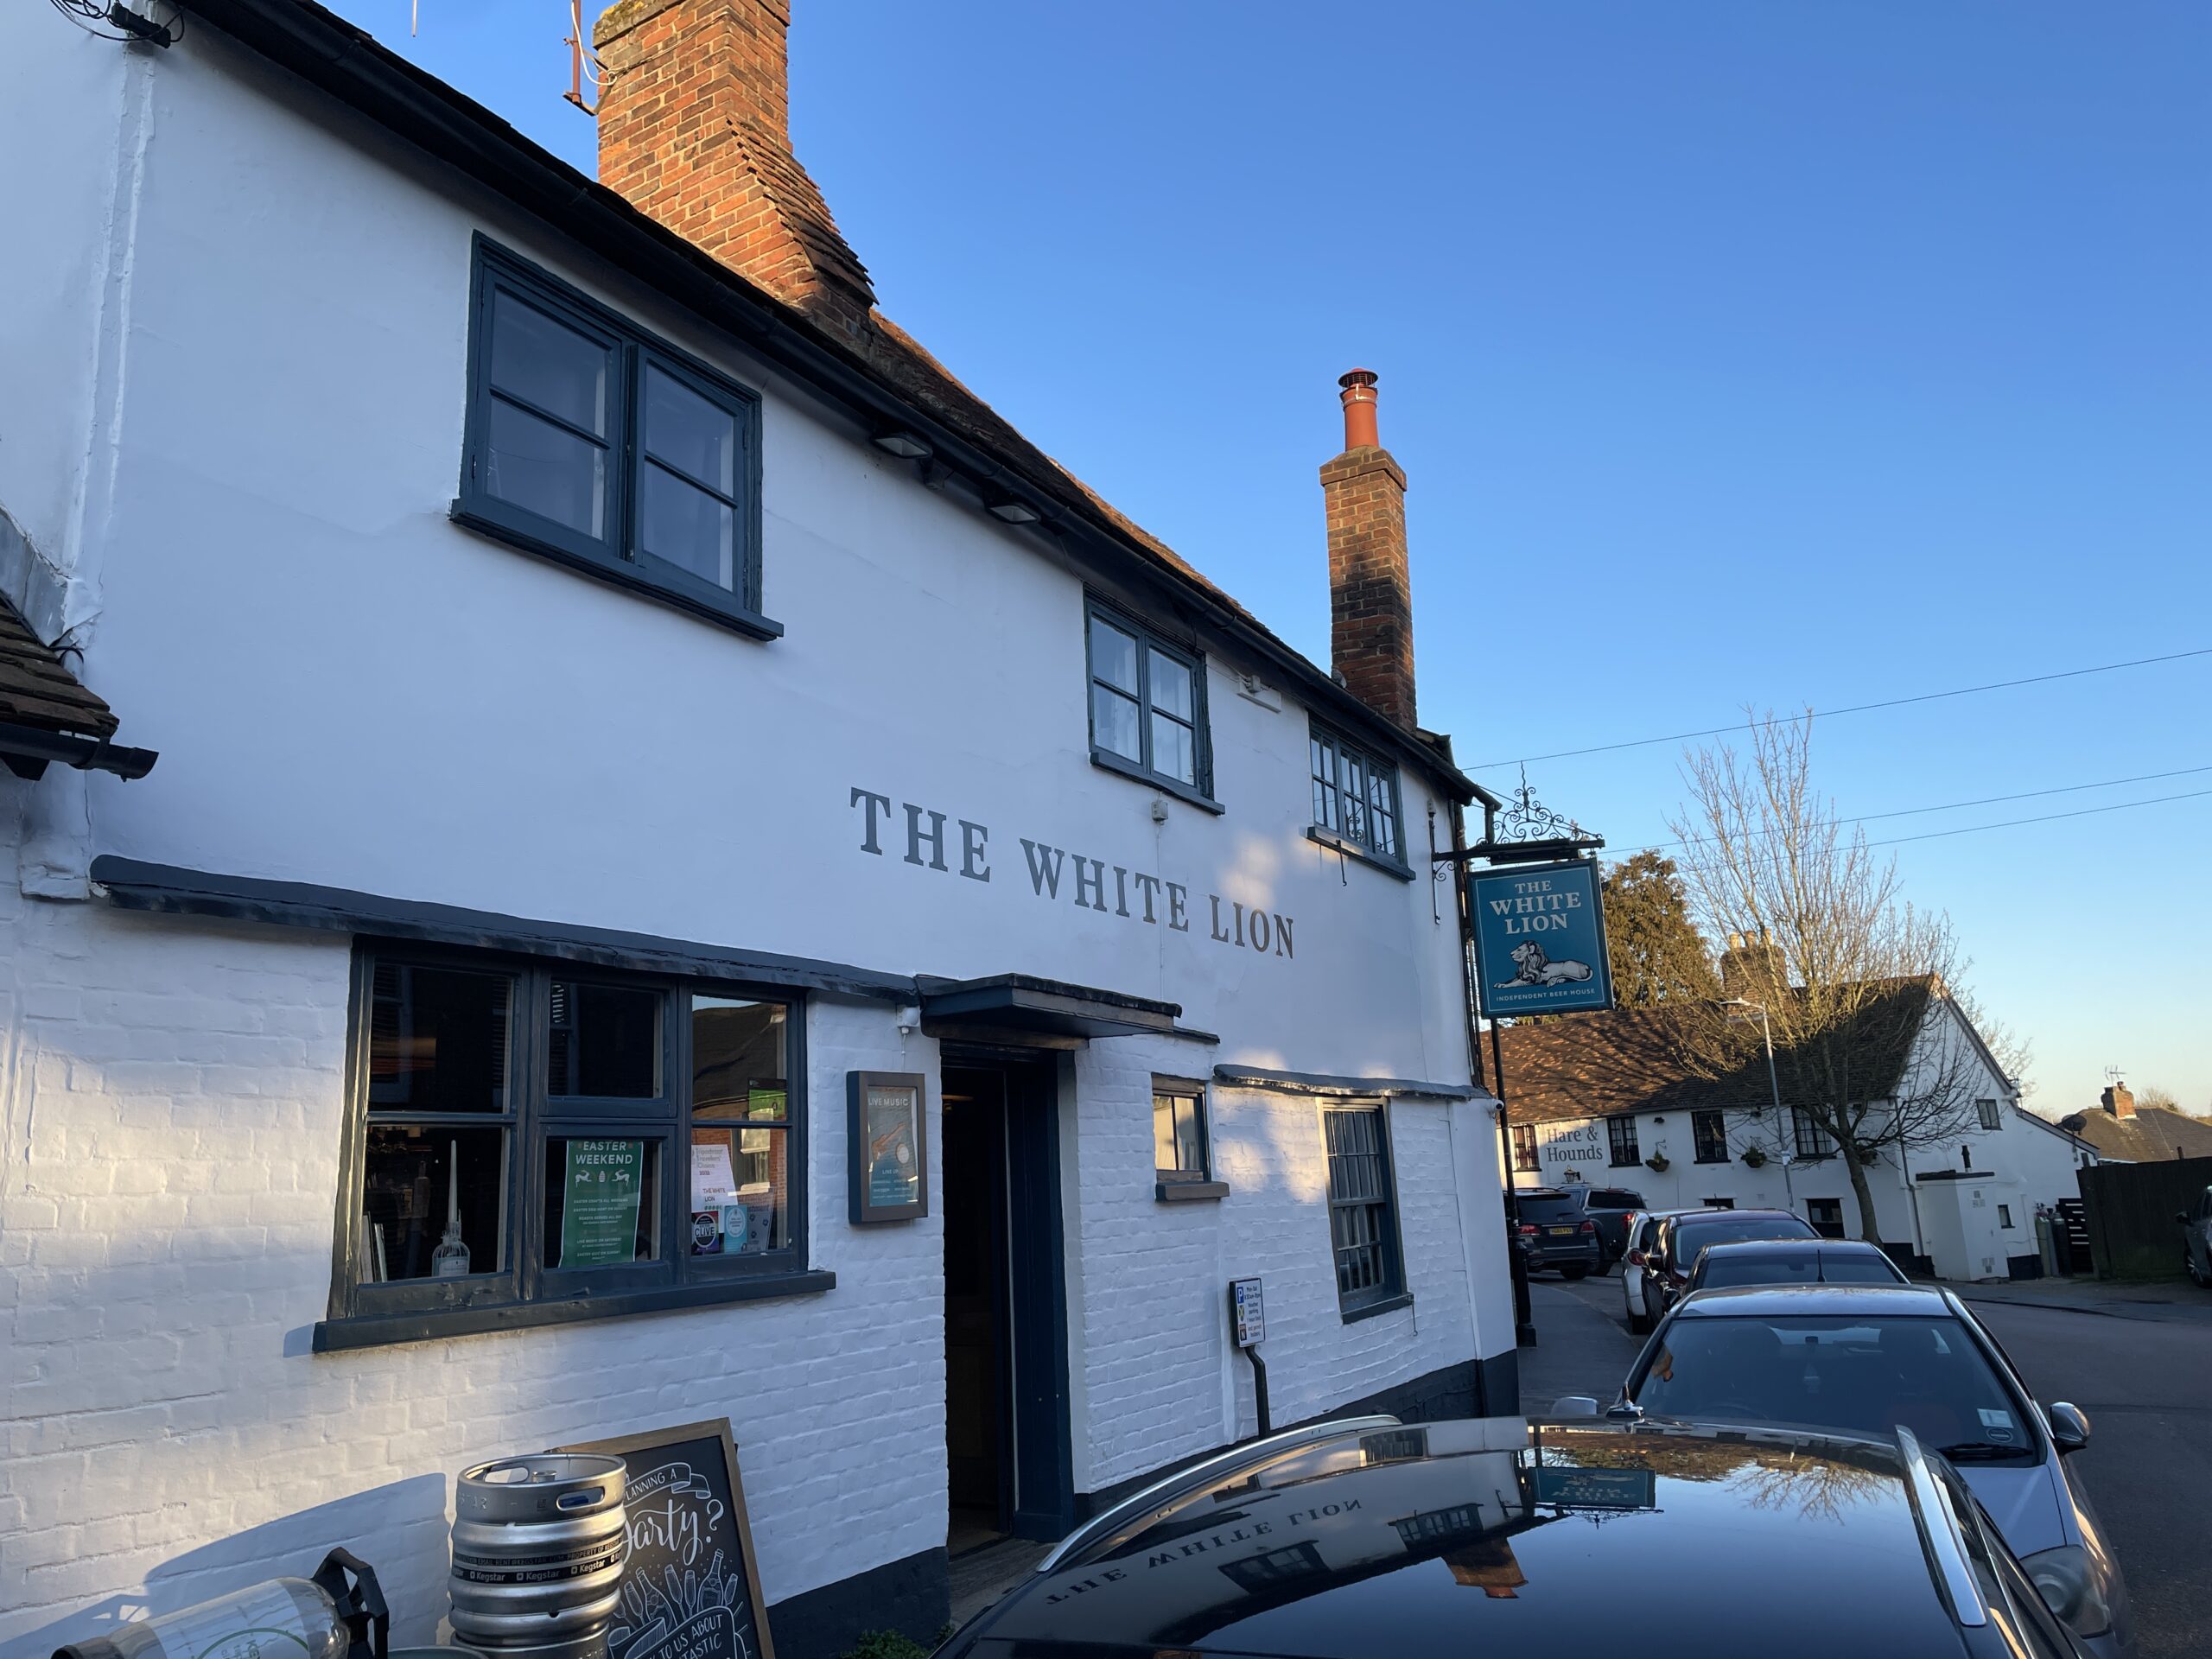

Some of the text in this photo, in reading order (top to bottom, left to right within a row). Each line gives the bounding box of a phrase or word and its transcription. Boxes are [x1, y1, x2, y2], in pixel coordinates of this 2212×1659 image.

[851, 787, 1294, 959] THE WHITE LION
[1515, 880, 1552, 894] THE
[1490, 892, 1581, 916] WHITE
[1504, 913, 1568, 934] LION
[1496, 992, 1547, 1002] INDEPENDENT
[868, 1097, 909, 1107] LIVE MUSIC
[1546, 1125, 1599, 1143] Hare &
[582, 1141, 626, 1151] EASTER
[1546, 1144, 1603, 1162] Hounds
[575, 1154, 633, 1165] WEEKEND
[694, 1227, 715, 1236] CLIVE
[1238, 1288, 1243, 1303] P
[625, 1468, 677, 1501] LANNING A
[567, 1548, 597, 1561] PROPERTY
[580, 1559, 606, 1573] Kegstar
[476, 1572, 505, 1582] Kegstar
[525, 1570, 559, 1581] Kegstar
[673, 1632, 689, 1652] US
[691, 1614, 722, 1640] ABOUT
